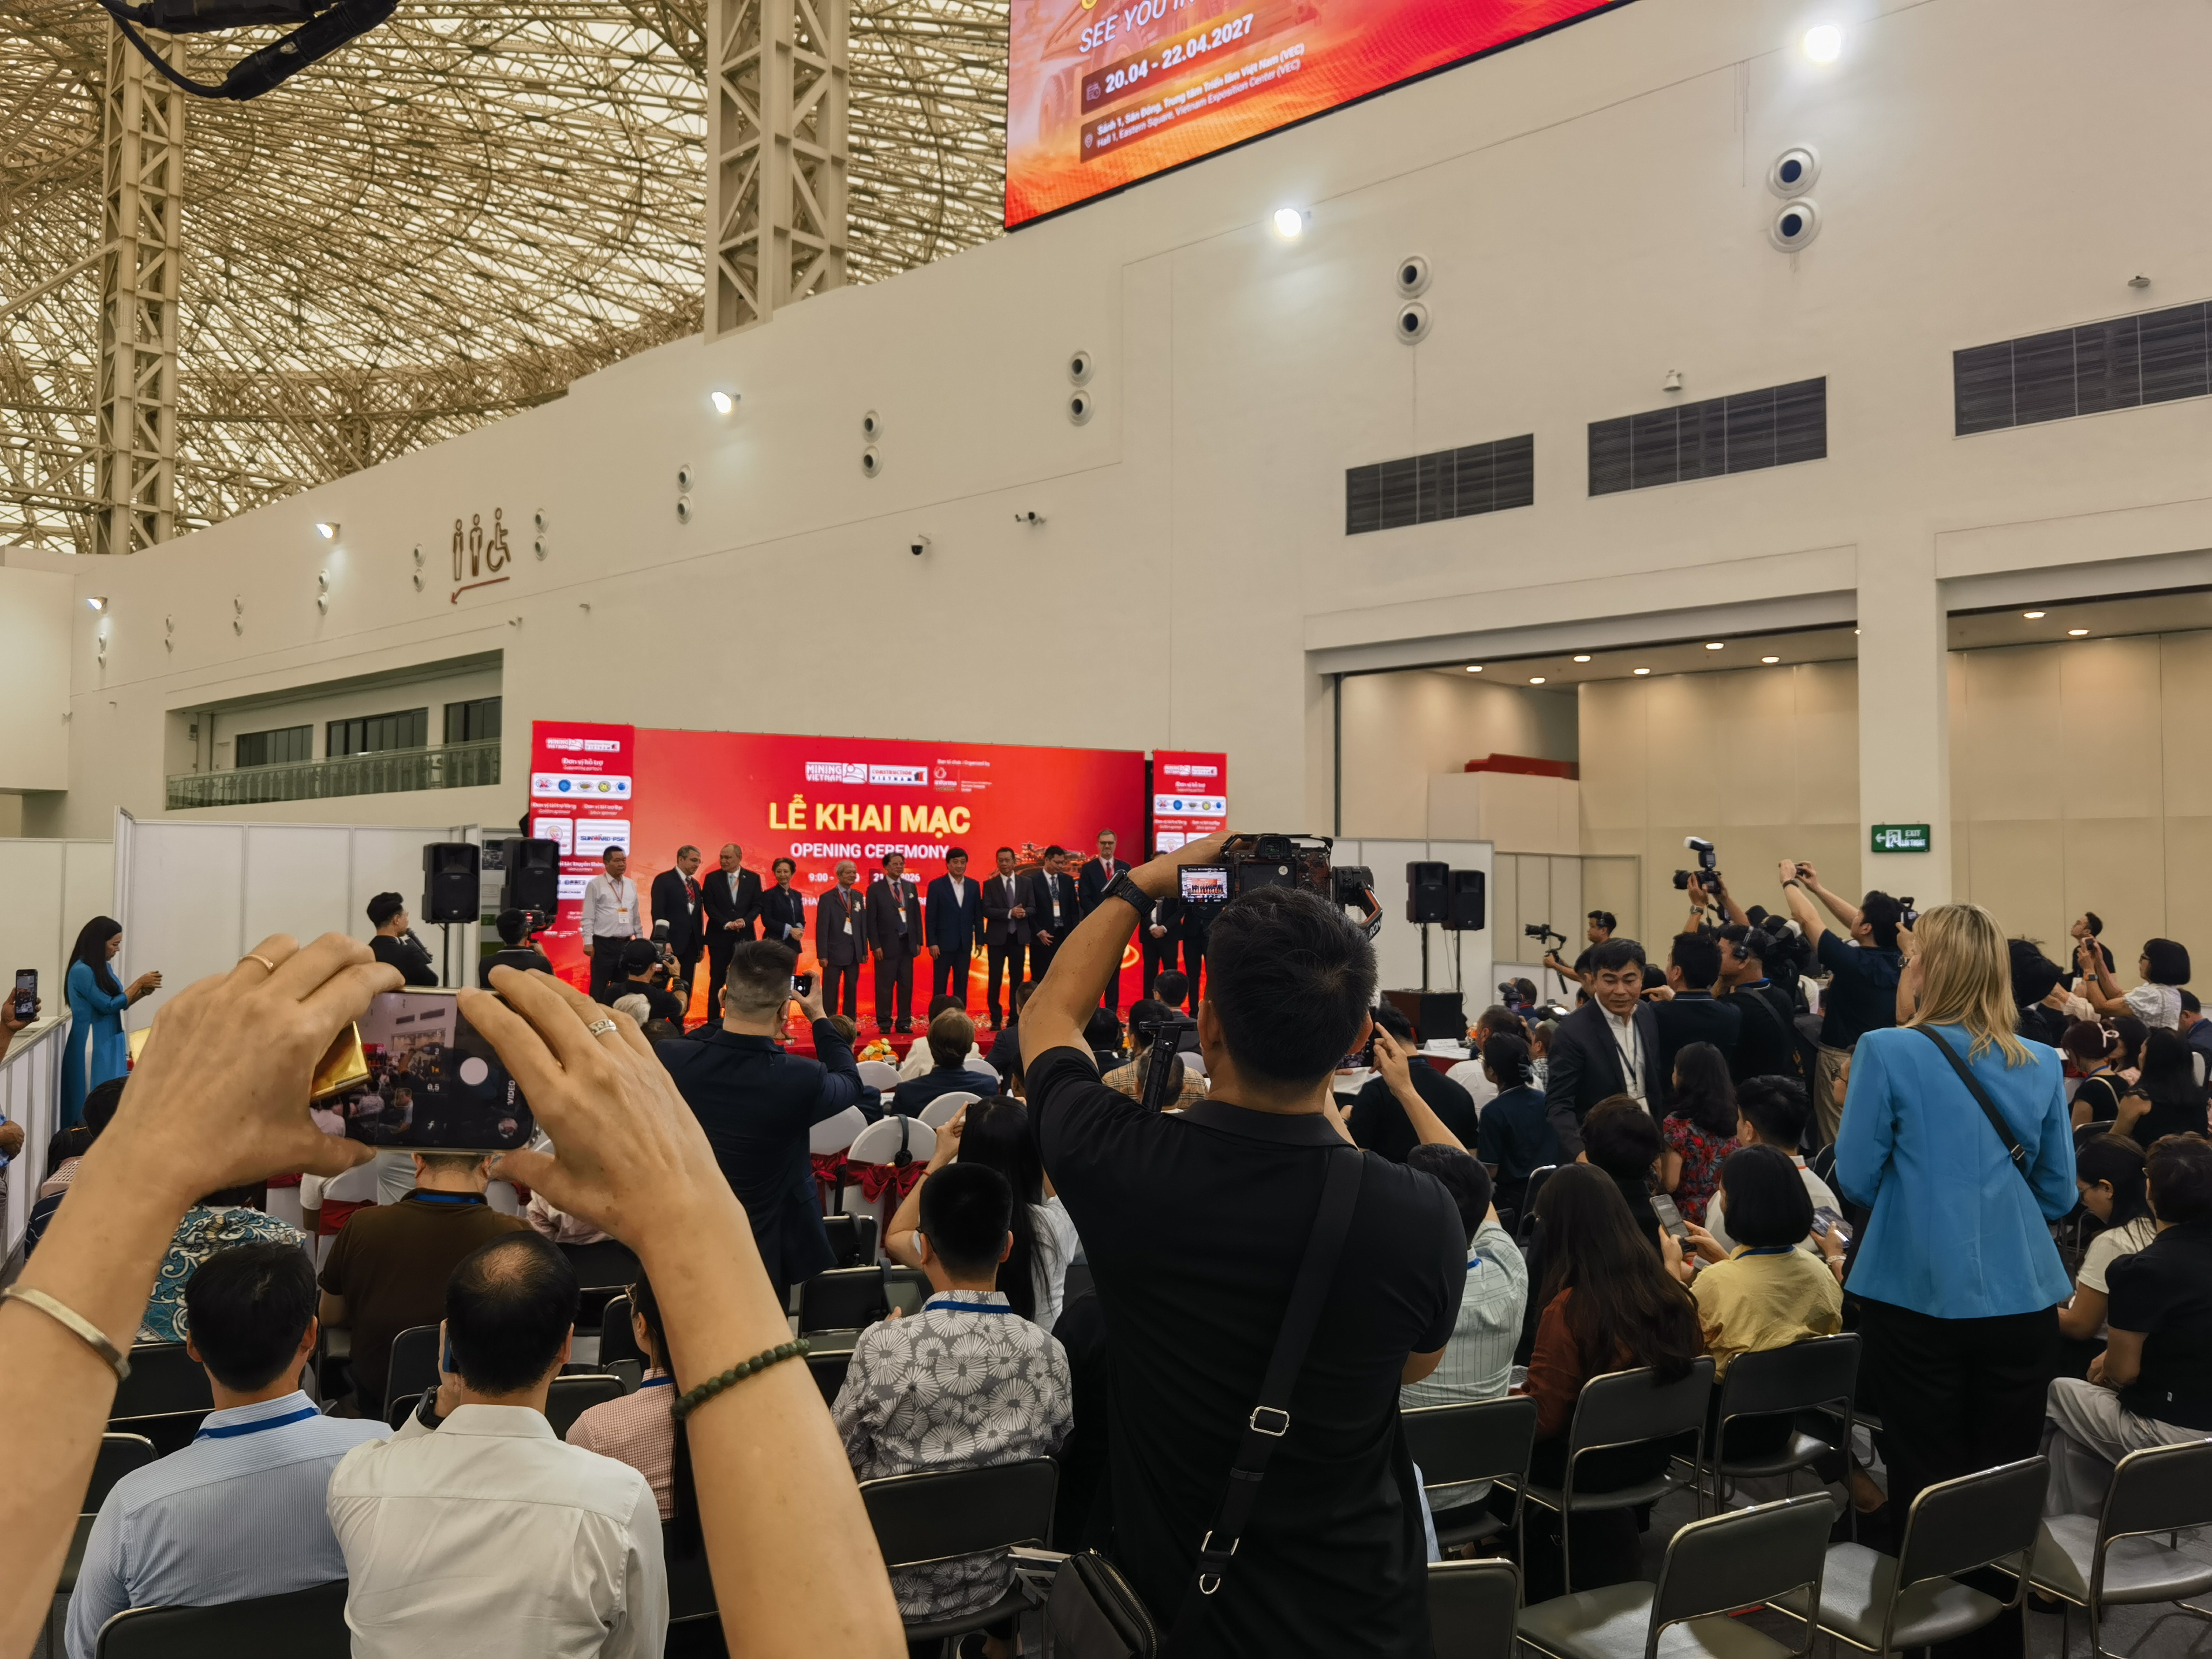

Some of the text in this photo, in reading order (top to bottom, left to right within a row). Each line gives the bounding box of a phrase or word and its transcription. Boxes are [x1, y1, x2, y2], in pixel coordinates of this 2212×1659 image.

[1079, 0, 1166, 53] SEE YOU
[1105, 59, 1148, 93] 20.04
[1162, 12, 1254, 70] 22.04.2027
[1164, 93, 1186, 109] Trung
[1259, 55, 1279, 70] Nam
[1280, 42, 1305, 63] (VEC)
[1096, 133, 1111, 148] Hall
[1118, 120, 1147, 139] Eastern
[1147, 110, 1175, 128] Square,
[1175, 97, 1207, 116] Vietnam
[1208, 80, 1249, 105] Exposition
[1249, 69, 1276, 88] Center
[1276, 58, 1301, 78] (VEC)
[807, 764, 842, 774] MINING
[807, 773, 842, 783] VIETNAM
[769, 793, 971, 839] LỄ KHAI MẠC
[790, 842, 949, 859] OPENING CEREMONY
[808, 873, 828, 882] 9:00
[507, 1080, 516, 1105] VIDEO
